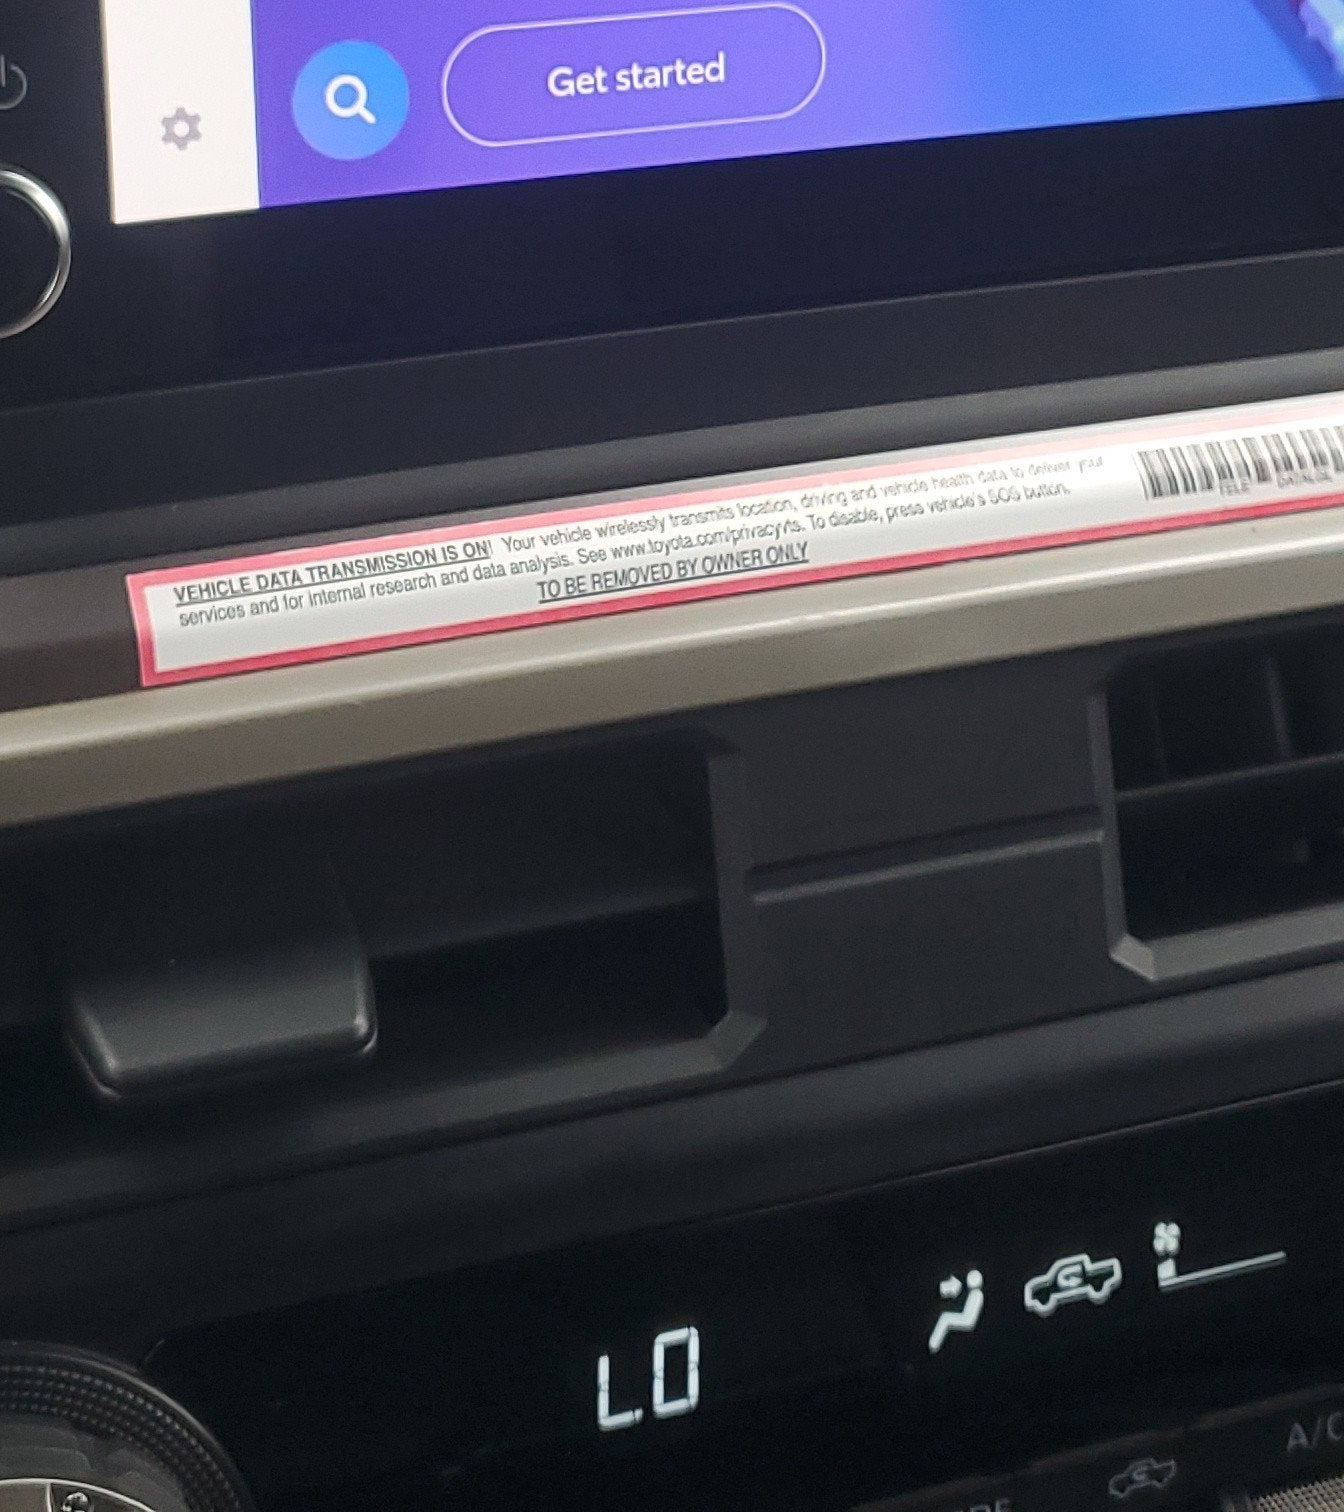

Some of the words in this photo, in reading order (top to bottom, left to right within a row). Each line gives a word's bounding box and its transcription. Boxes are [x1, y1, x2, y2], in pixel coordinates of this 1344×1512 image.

[547, 64, 609, 99] Get
[615, 51, 726, 93] started
[174, 575, 251, 604] VEHICLE
[256, 568, 305, 594] DATA
[306, 549, 438, 588] TRANSMISSION
[441, 544, 460, 562] IS
[462, 538, 494, 559] ON!
[502, 534, 537, 554] Your
[540, 524, 592, 546] vehicle
[595, 512, 666, 538] wirelessly
[669, 503, 735, 528] transmits
[178, 604, 246, 627] services
[249, 596, 280, 617] and
[282, 591, 305, 610] for
[308, 581, 367, 608] internal
[370, 569, 438, 599] research
[440, 563, 470, 587] and
[472, 557, 506, 581] data
[509, 551, 574, 576] analysis.
[577, 546, 608, 565] See
[806, 513, 826, 531] To
[886, 502, 925, 524] press
[988, 486, 1022, 505] SOS
[536, 579, 561, 601] TO
[564, 573, 594, 598] BE
[591, 563, 673, 591] REMOVED
[676, 556, 700, 577] BY
[700, 546, 764, 576] OWNER
[765, 541, 809, 565] ONLY
[597, 1326, 700, 1431] LO
